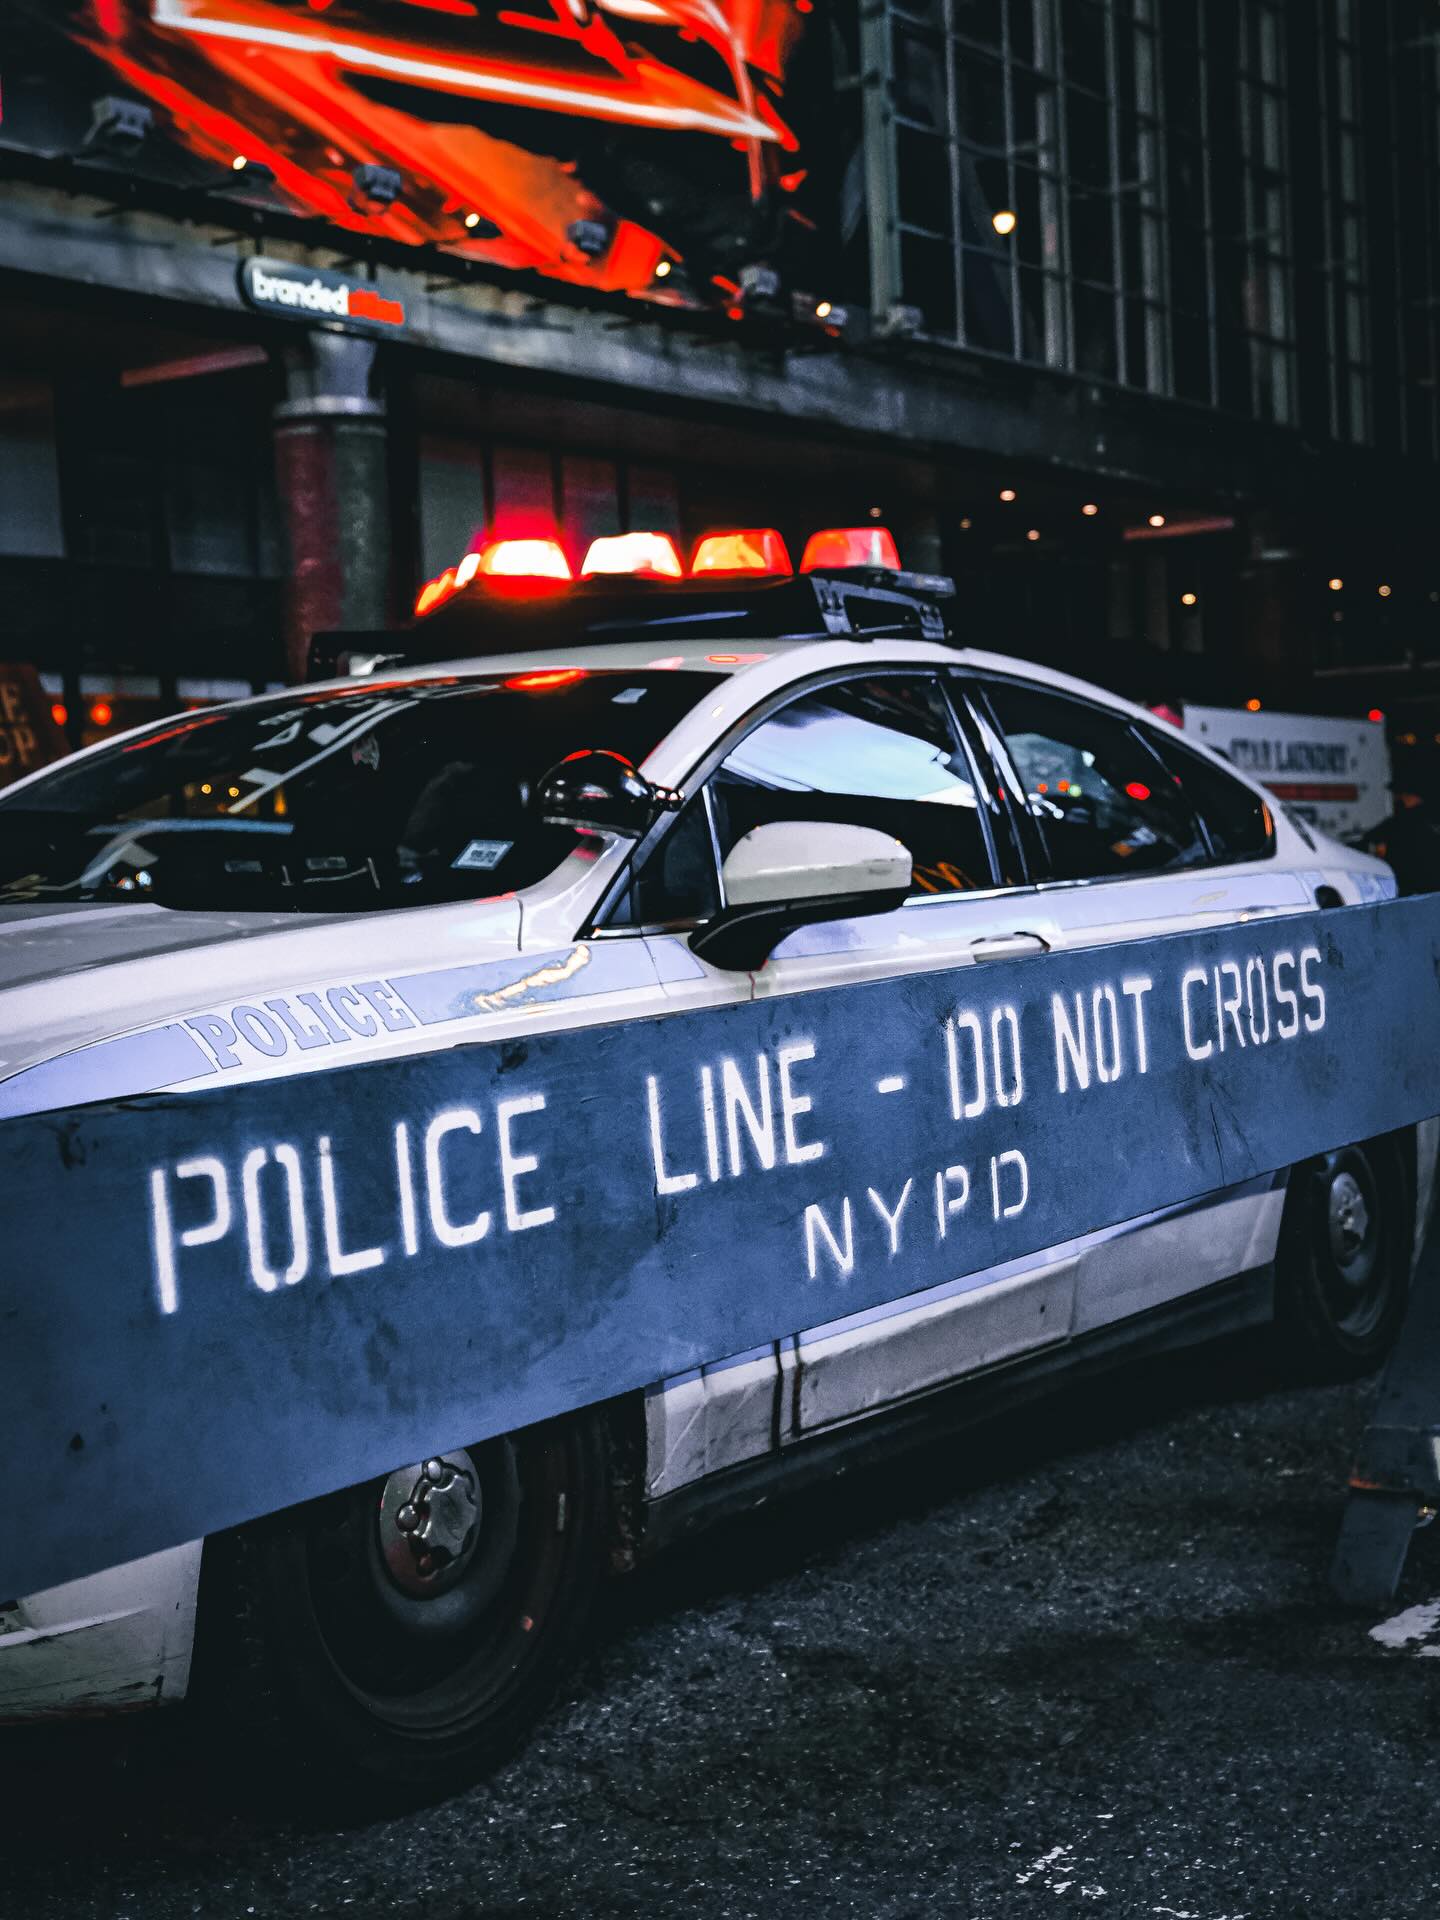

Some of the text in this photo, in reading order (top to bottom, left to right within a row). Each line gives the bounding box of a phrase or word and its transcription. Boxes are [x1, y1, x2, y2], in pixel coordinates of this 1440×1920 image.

[185, 980, 415, 1070] POLICE
[150, 1094, 556, 1315] POLICE
[647, 1042, 824, 1195] LINE
[945, 1005, 1023, 1121] DO
[1052, 977, 1153, 1094] NOT
[1181, 947, 1326, 1061] CROSS
[804, 1149, 1030, 1279] NYPD
